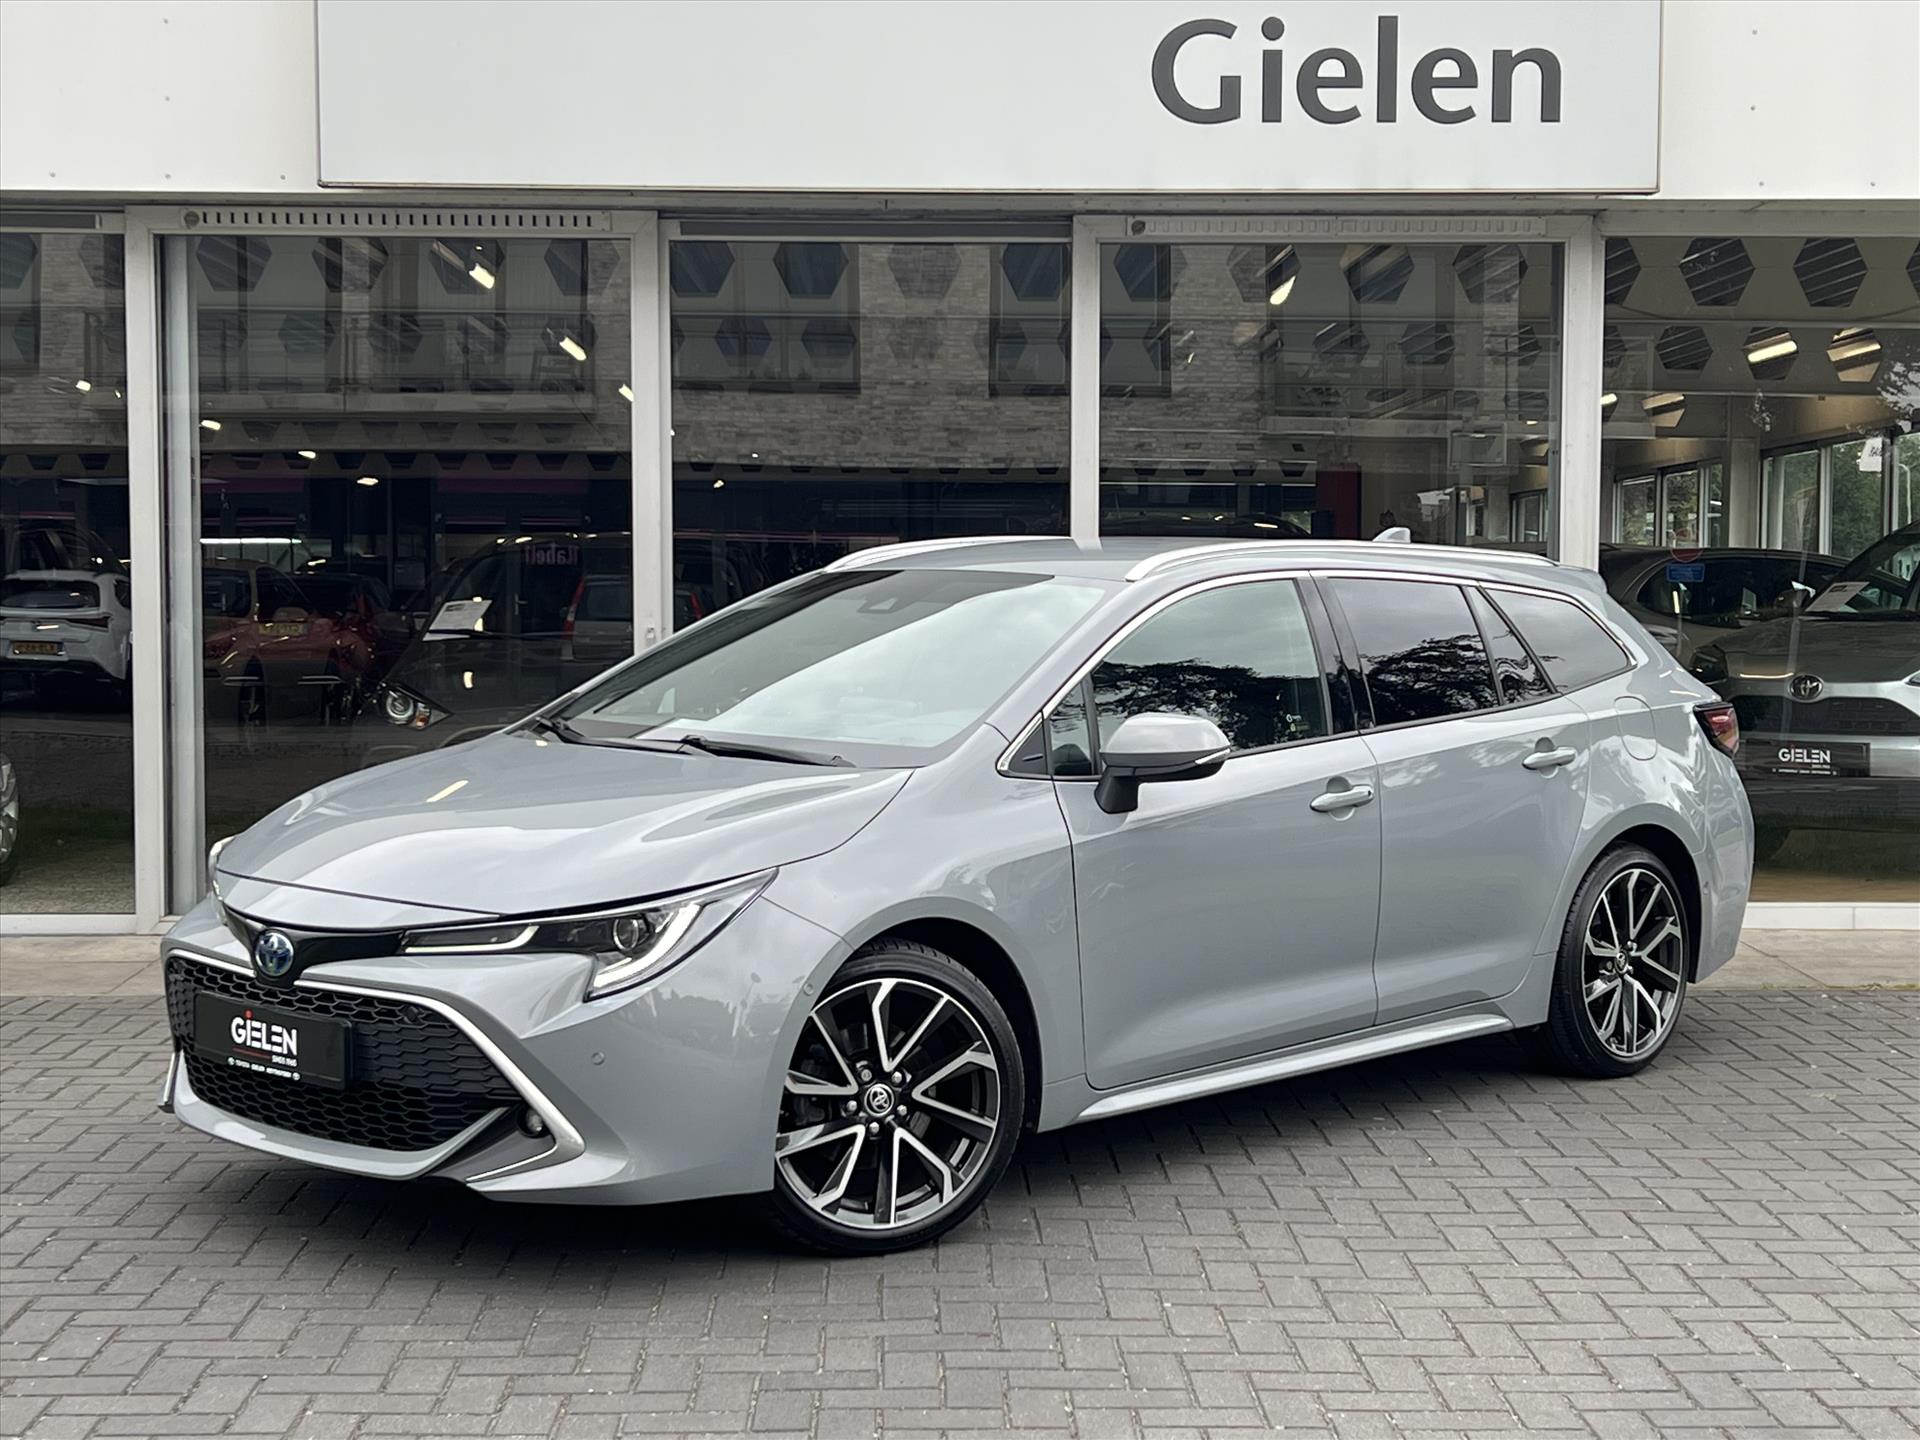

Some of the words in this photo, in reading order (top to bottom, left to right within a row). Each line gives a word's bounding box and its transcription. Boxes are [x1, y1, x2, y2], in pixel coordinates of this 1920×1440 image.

[1152, 15, 1562, 125] Gielen
[1778, 745, 1831, 763] GIELEN
[231, 1010, 298, 1056] GIELEN
